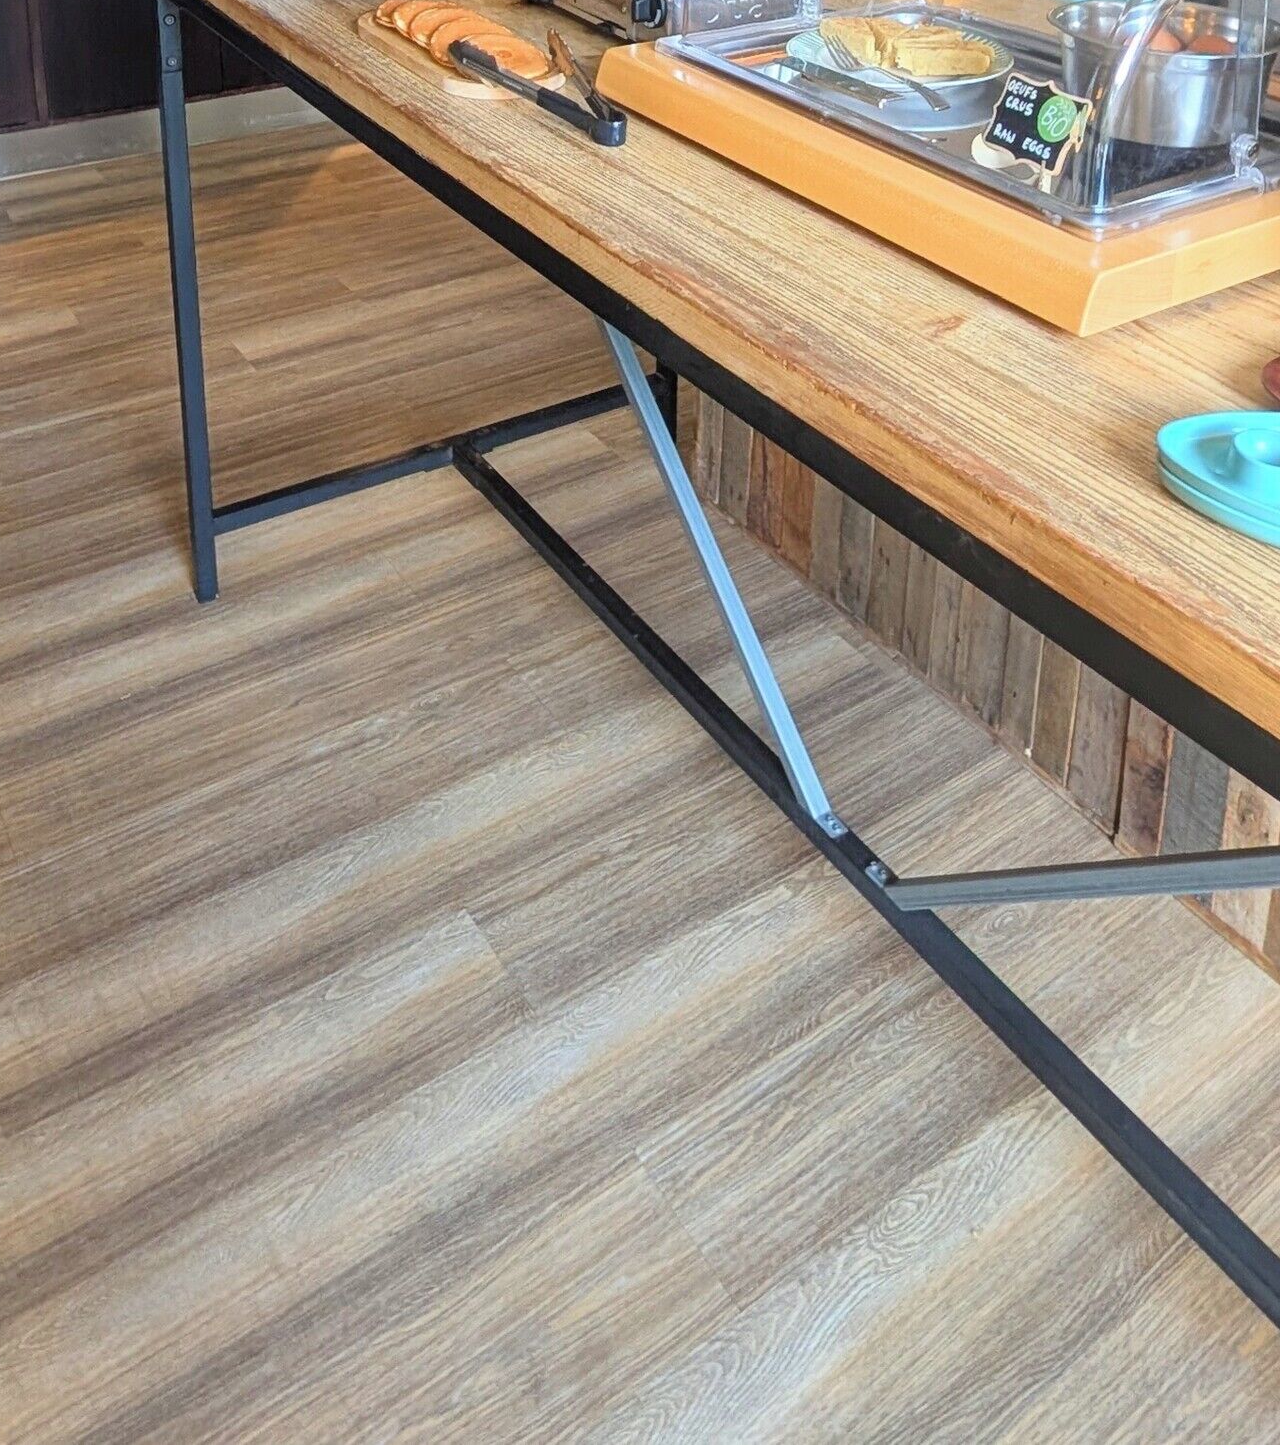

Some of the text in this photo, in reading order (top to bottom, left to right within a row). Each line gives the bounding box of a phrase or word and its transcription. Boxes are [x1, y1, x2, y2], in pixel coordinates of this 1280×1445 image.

[1007, 79, 1038, 100] OEUFS
[1005, 95, 1034, 116] CRUS
[993, 122, 1052, 160] RAW EGGS
